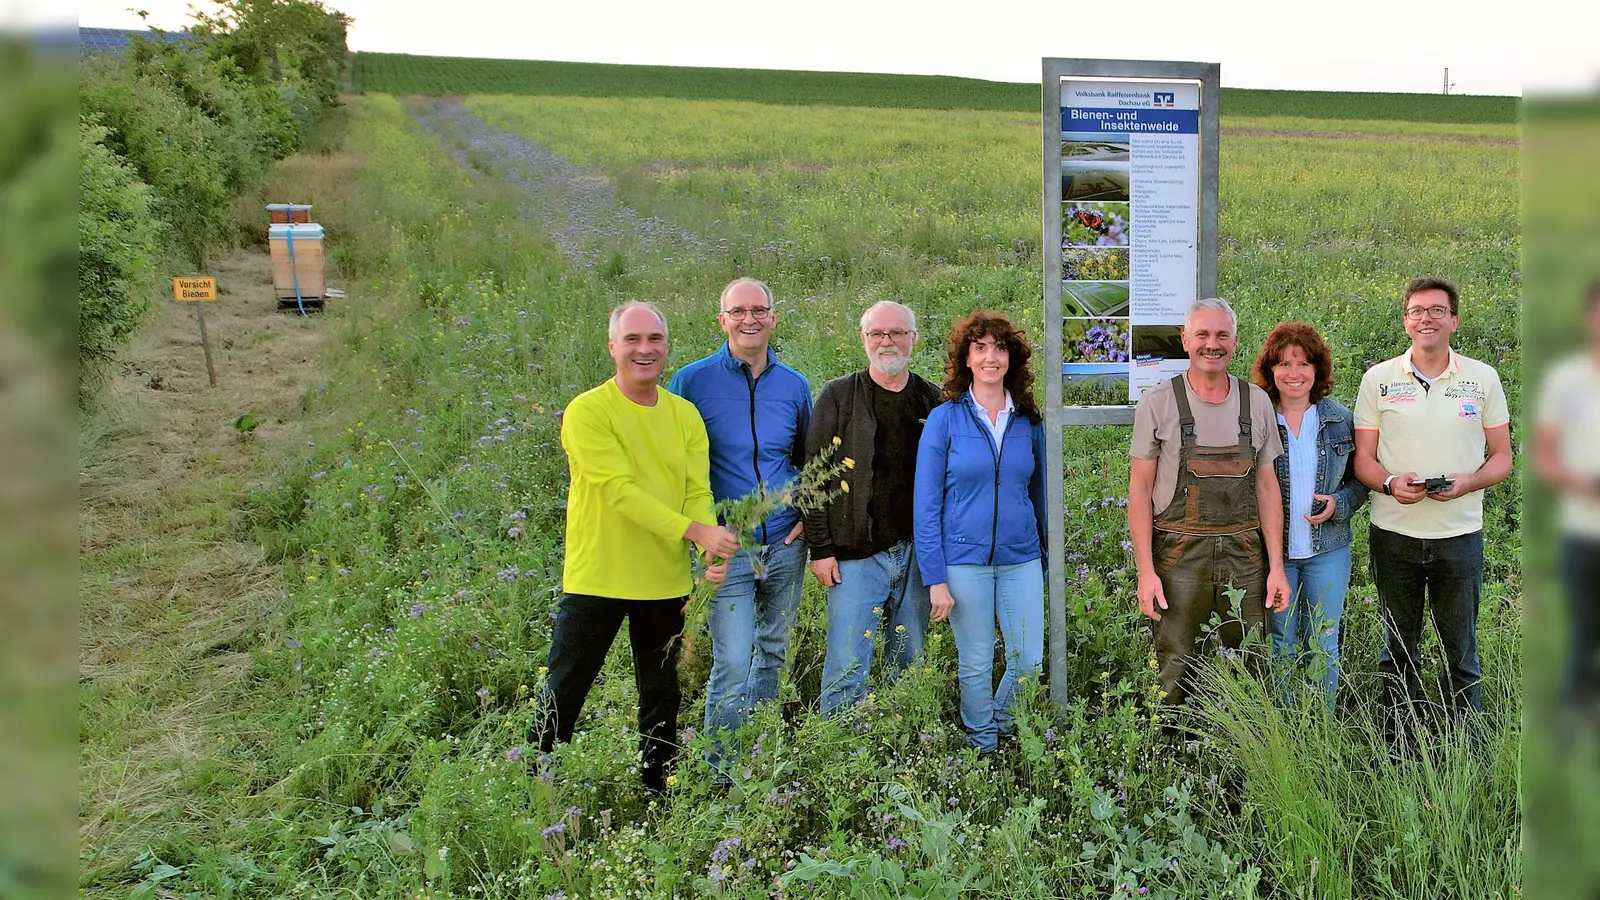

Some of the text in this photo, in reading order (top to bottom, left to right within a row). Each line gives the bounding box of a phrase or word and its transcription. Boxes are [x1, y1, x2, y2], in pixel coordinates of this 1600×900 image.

[1107, 91, 1150, 99] Raiffeisenbank
[1070, 109, 1137, 121] Bienen- und
[1101, 120, 1179, 132] Insektenweide
[179, 279, 211, 288] Vorsicht
[182, 290, 210, 298] Bienen
